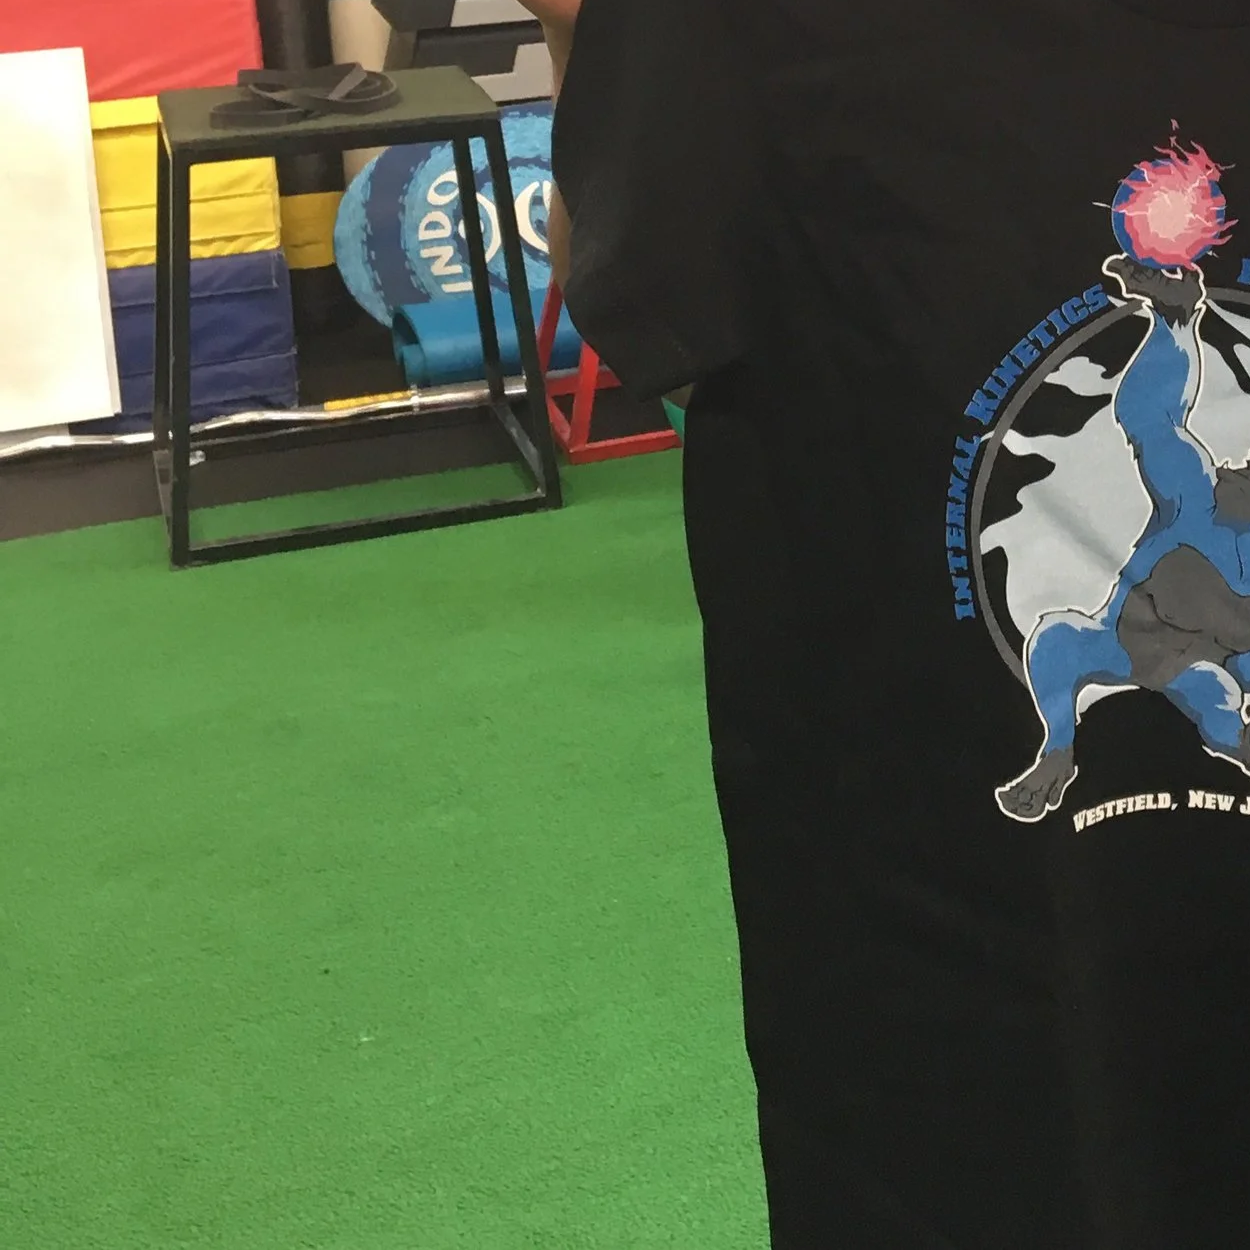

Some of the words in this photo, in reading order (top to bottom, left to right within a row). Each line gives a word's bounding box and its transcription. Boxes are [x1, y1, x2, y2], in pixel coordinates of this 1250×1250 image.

[417, 169, 474, 294] INDO
[946, 434, 982, 621] INTERNAL
[964, 283, 1111, 426] KINETICS
[1072, 792, 1178, 833] WESTFIELD,
[1188, 789, 1236, 812] NEW
